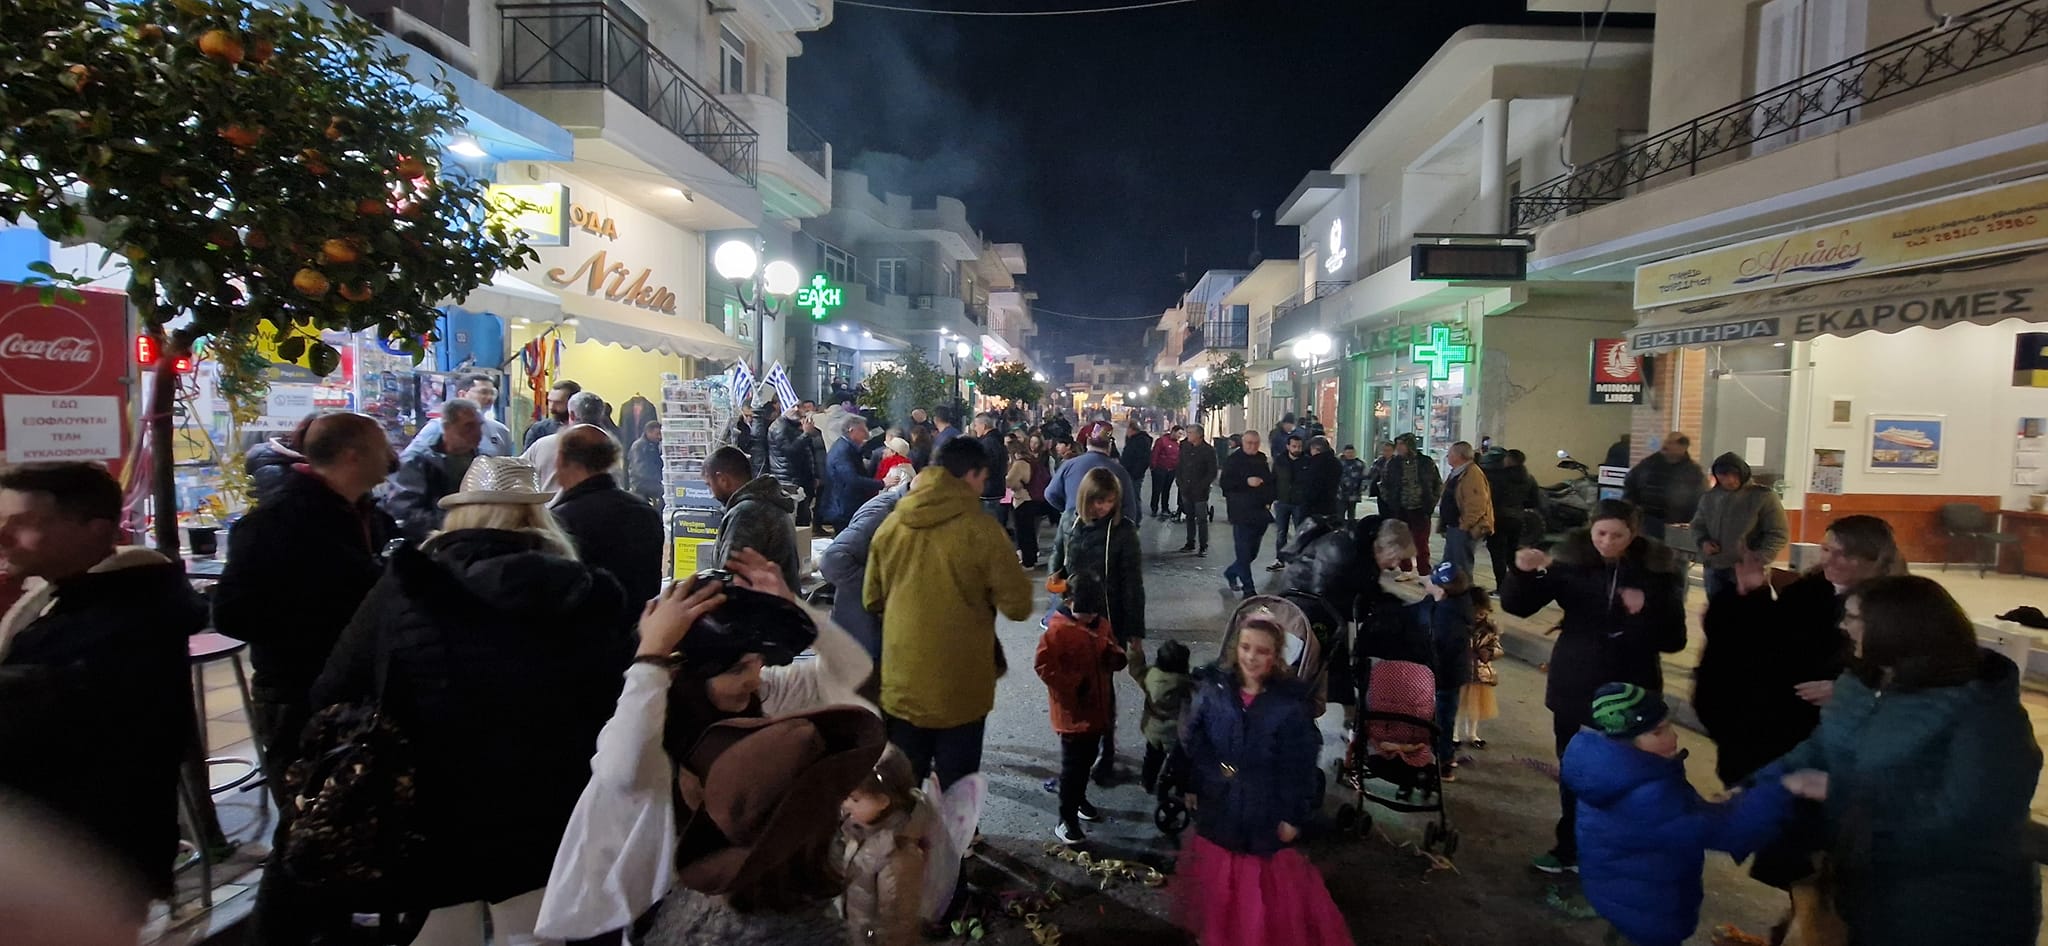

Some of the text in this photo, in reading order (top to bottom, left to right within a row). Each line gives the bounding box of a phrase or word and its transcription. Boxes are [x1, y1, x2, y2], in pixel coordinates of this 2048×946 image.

[569, 202, 618, 241] ΟΔΑ
[1636, 319, 1773, 349] ΕΙΣΙΤΗΡΙΑ
[1794, 287, 2034, 335] ΕΚΔΡΟΜΕΣ
[1596, 383, 1641, 393] MINOAN
[1604, 393, 1635, 403] LINES
[51, 399, 78, 409] ΕΔΩ
[51, 432, 81, 442] ΤΕΛΗ
